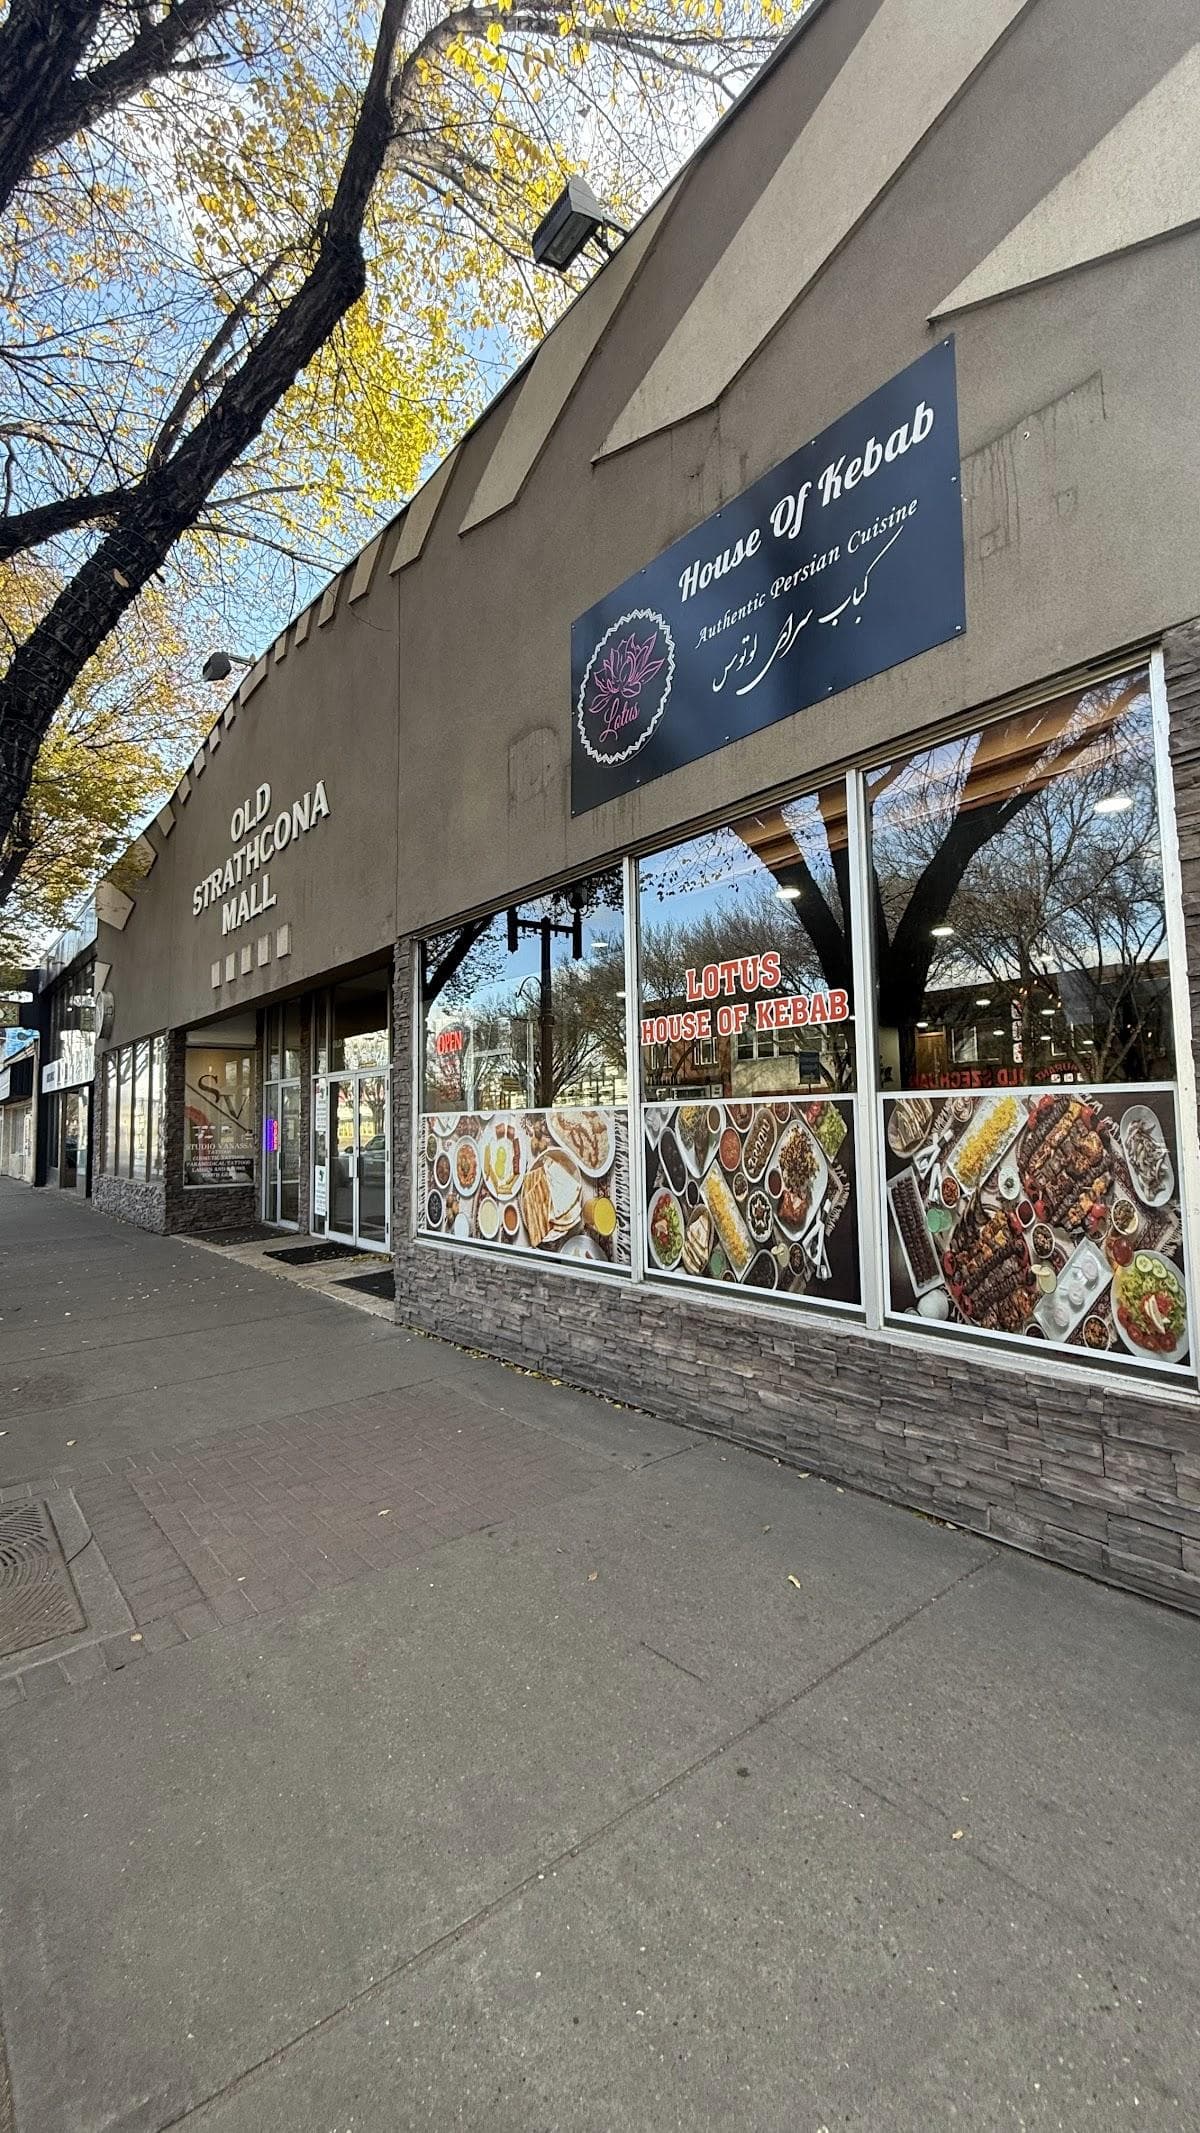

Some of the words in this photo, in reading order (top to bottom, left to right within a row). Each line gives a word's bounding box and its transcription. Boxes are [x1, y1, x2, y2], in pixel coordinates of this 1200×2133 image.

[678, 529, 761, 602] House
[770, 480, 812, 540] Of
[818, 401, 935, 507] Kebab
[695, 592, 766, 649] Authentic
[770, 546, 840, 600] Persian
[847, 498, 918, 554] Cuisine
[600, 698, 639, 743] Lotus
[231, 782, 272, 843] OLD
[193, 780, 331, 916] STRATHCONA
[222, 873, 278, 936] MALL
[686, 951, 782, 1003] LOTUS
[436, 1030, 463, 1055] OPEN
[641, 1009, 712, 1046] HOUSE
[717, 1003, 750, 1036] OF
[755, 988, 850, 1031] KEBAB
